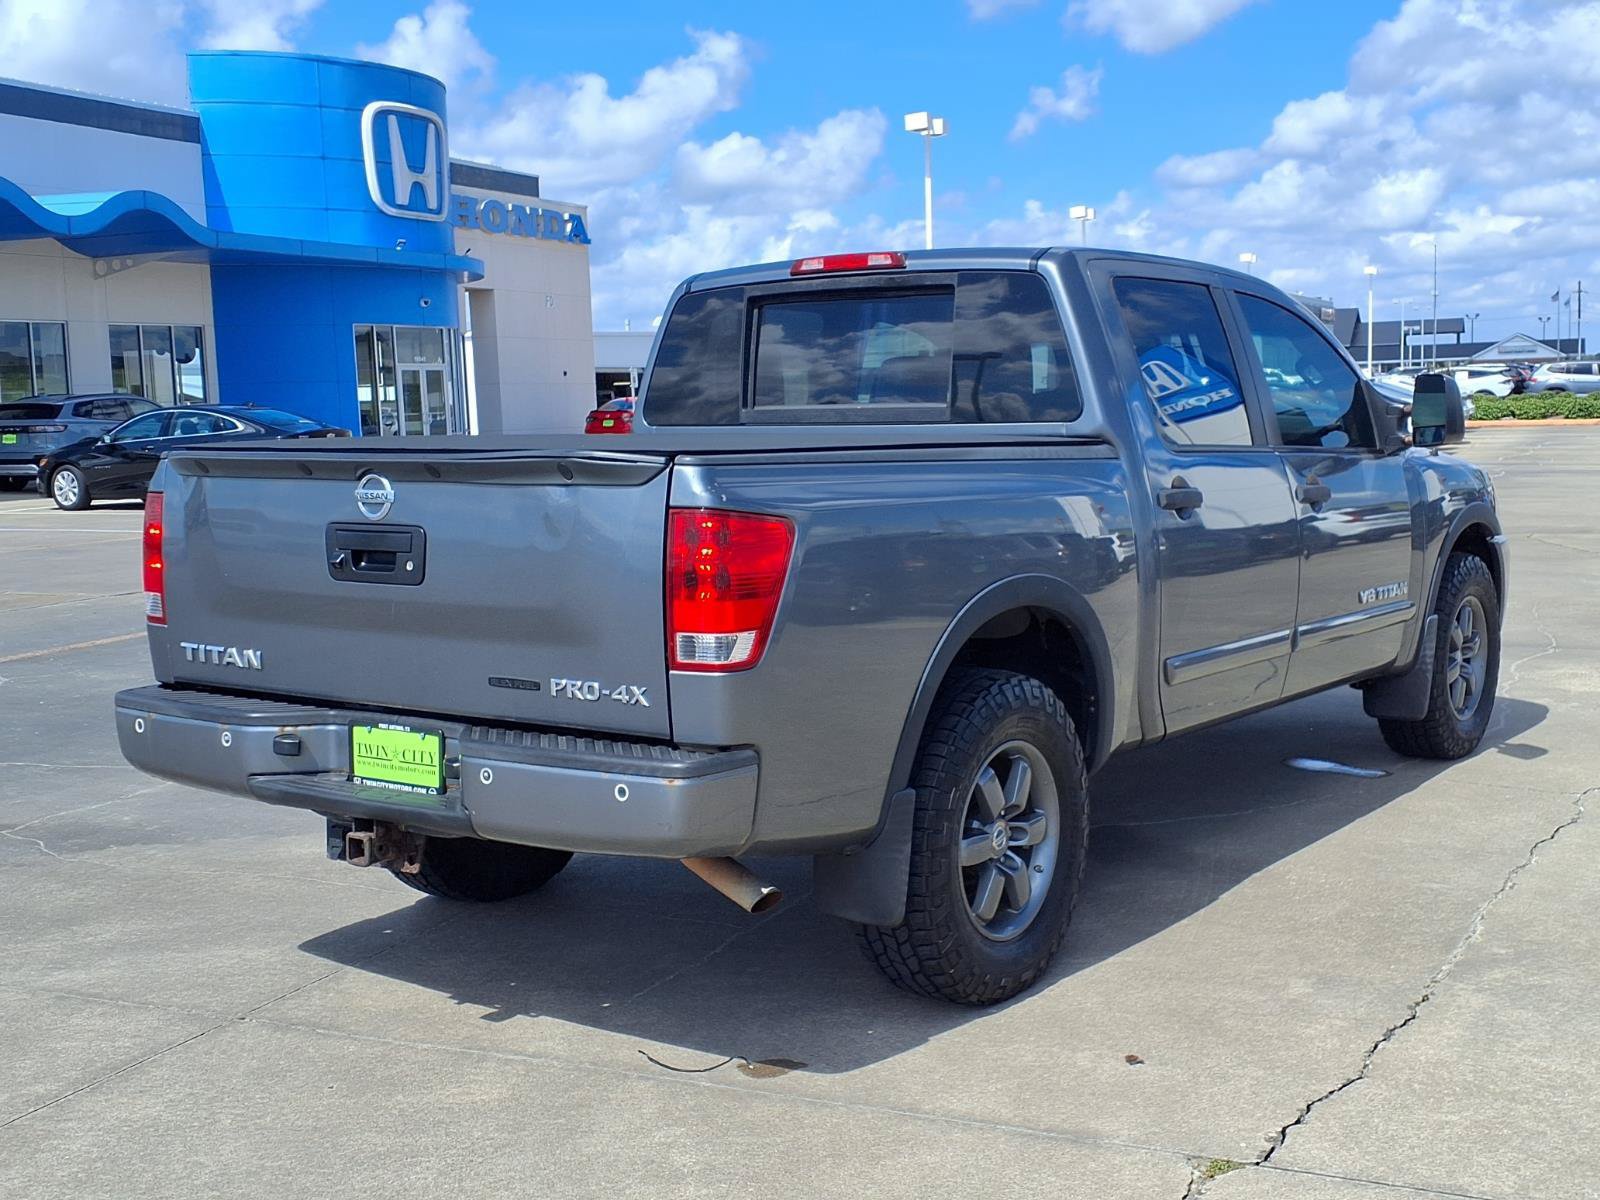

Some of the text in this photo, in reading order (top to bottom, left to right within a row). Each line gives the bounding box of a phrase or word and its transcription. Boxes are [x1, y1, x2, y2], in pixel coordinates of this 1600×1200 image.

[450, 194, 591, 244] HONDA
[356, 491, 389, 500] NISSAN
[1360, 581, 1409, 604] V8 TITAN
[180, 641, 262, 670] TITAN
[550, 678, 650, 707] PRO-4X
[356, 742, 436, 764] TWIN CITY
